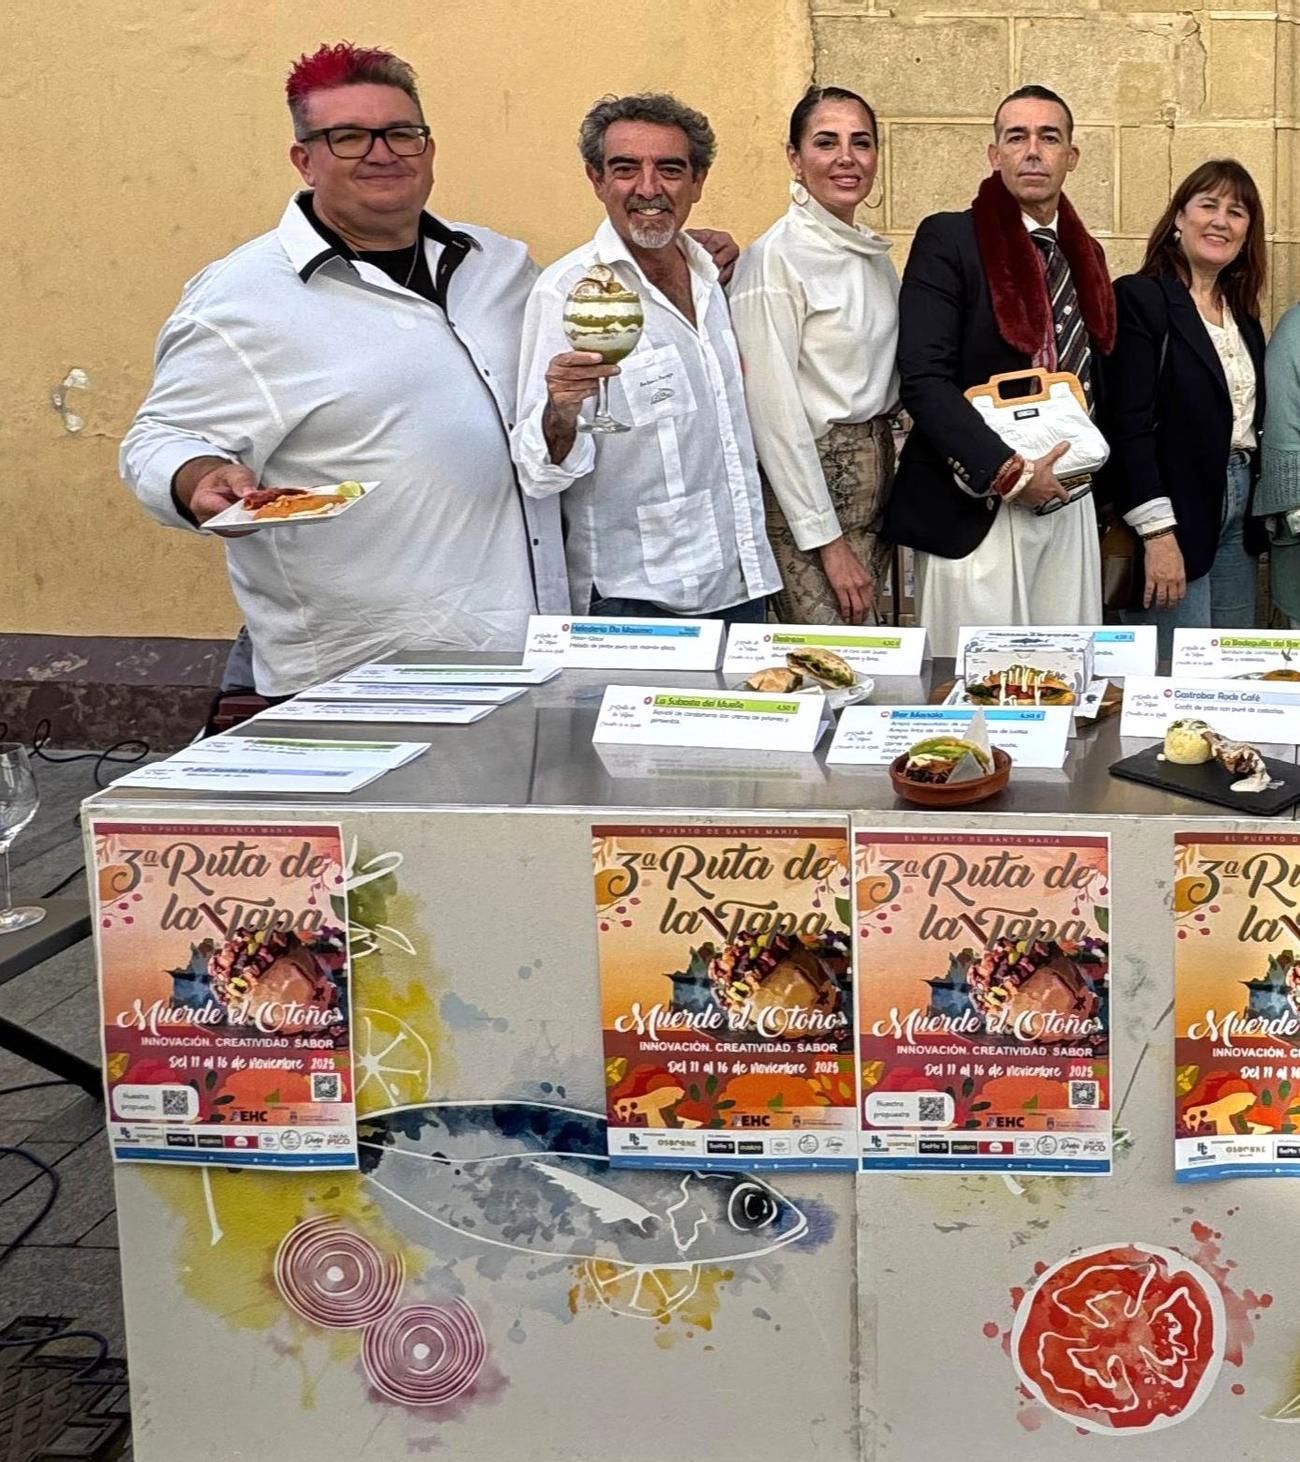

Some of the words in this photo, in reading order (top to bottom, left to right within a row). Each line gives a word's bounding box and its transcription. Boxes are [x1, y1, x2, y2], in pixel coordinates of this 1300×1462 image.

[1174, 690, 1215, 700] Gastrobar
[1218, 692, 1239, 701] Rock
[1240, 692, 1261, 702] Café
[112, 849, 158, 893] 3ª
[161, 840, 271, 896] Ruta
[279, 841, 329, 878] de
[607, 851, 657, 897] 3ª
[660, 842, 774, 900] Ruta
[783, 843, 836, 881] de
[869, 858, 920, 903] 3ª
[921, 850, 1035, 906] Ruta
[1043, 851, 1097, 889] de
[1188, 859, 1240, 904] 3ª
[161, 892, 204, 931] la
[212, 896, 327, 946] Tapa
[659, 897, 704, 934] la
[714, 900, 832, 948] Tapa
[918, 903, 964, 941] la
[974, 907, 1091, 955] Tapa
[1237, 905, 1284, 942] la
[117, 999, 222, 1036] Muerde
[227, 1000, 249, 1027] el
[254, 1001, 333, 1034] Otoño
[614, 1001, 723, 1041] Muerde
[728, 1003, 750, 1029] el
[757, 1005, 837, 1038] Otoño
[871, 1007, 981, 1045] Muerde
[985, 1008, 1007, 1034] el
[1013, 1010, 1094, 1041] Otoño
[1187, 1009, 1300, 1047] Muerde
[141, 1035, 212, 1048] INNOVACIÓN.
[294, 1038, 334, 1049] SABOR
[639, 1040, 713, 1052] INNOVACIÓN.
[715, 1042, 794, 1053] CREATIVIDAD.
[797, 1042, 838, 1053] SABOR
[896, 1044, 970, 1056] INNOVACIÓN.
[1052, 1046, 1093, 1058] SABOR
[1212, 1046, 1287, 1058] INNOVACIÓN.
[168, 1056, 188, 1069] Del
[190, 1056, 200, 1068] 11
[203, 1056, 214, 1070] al
[216, 1056, 228, 1069] 16
[230, 1056, 246, 1070] de
[249, 1057, 304, 1070] noviembre
[310, 1057, 336, 1070] 2025
[668, 1060, 687, 1074] Del
[690, 1061, 700, 1074] 11
[703, 1060, 714, 1074] al
[718, 1061, 729, 1074] 16
[732, 1061, 748, 1074] de
[750, 1062, 807, 1074] noviembre
[814, 1062, 839, 1074] 2025
[924, 1064, 944, 1076] Del
[946, 1064, 956, 1076] 11
[960, 1064, 970, 1077] al
[974, 1064, 984, 1076] 16
[988, 1064, 1004, 1077] de
[1006, 1065, 1062, 1078] noviembre
[1068, 1065, 1094, 1077] 2025
